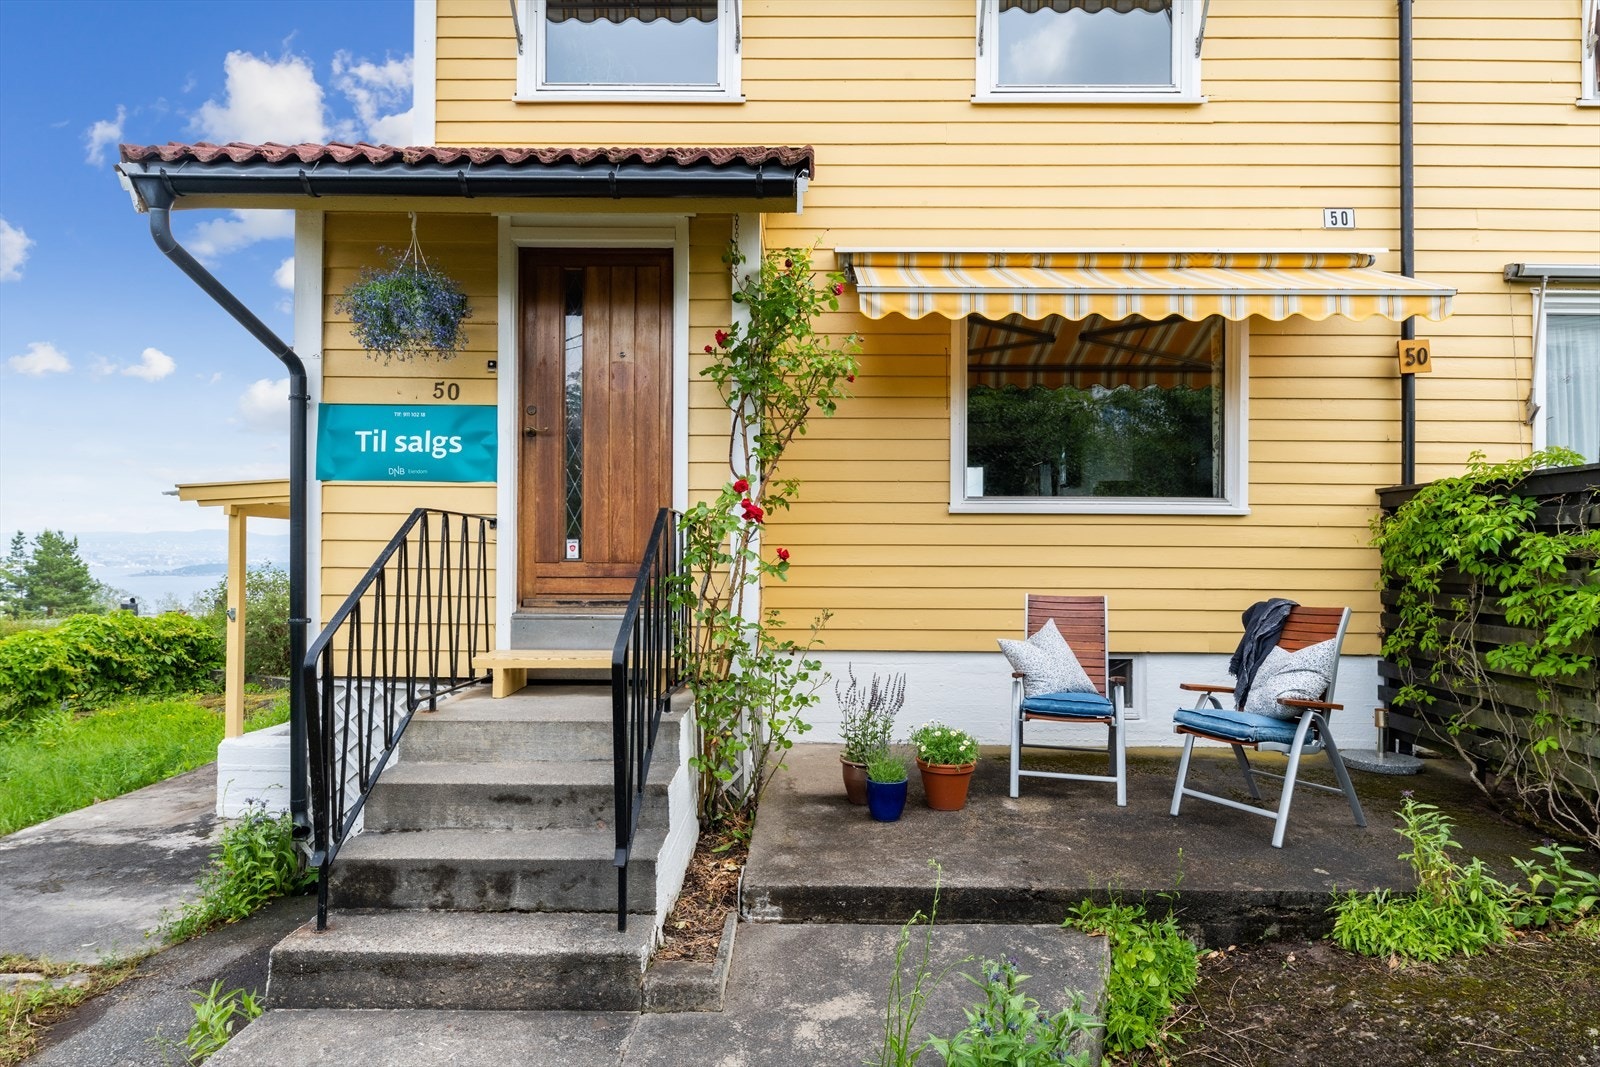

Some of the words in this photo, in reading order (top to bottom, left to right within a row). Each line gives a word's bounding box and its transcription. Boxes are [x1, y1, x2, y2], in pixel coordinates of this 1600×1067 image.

[1330, 211, 1348, 226] 50
[1405, 347, 1428, 366] 50
[432, 381, 460, 401] 50
[355, 429, 387, 453] Til
[394, 430, 462, 459] salgs
[388, 465, 405, 477] DNB
